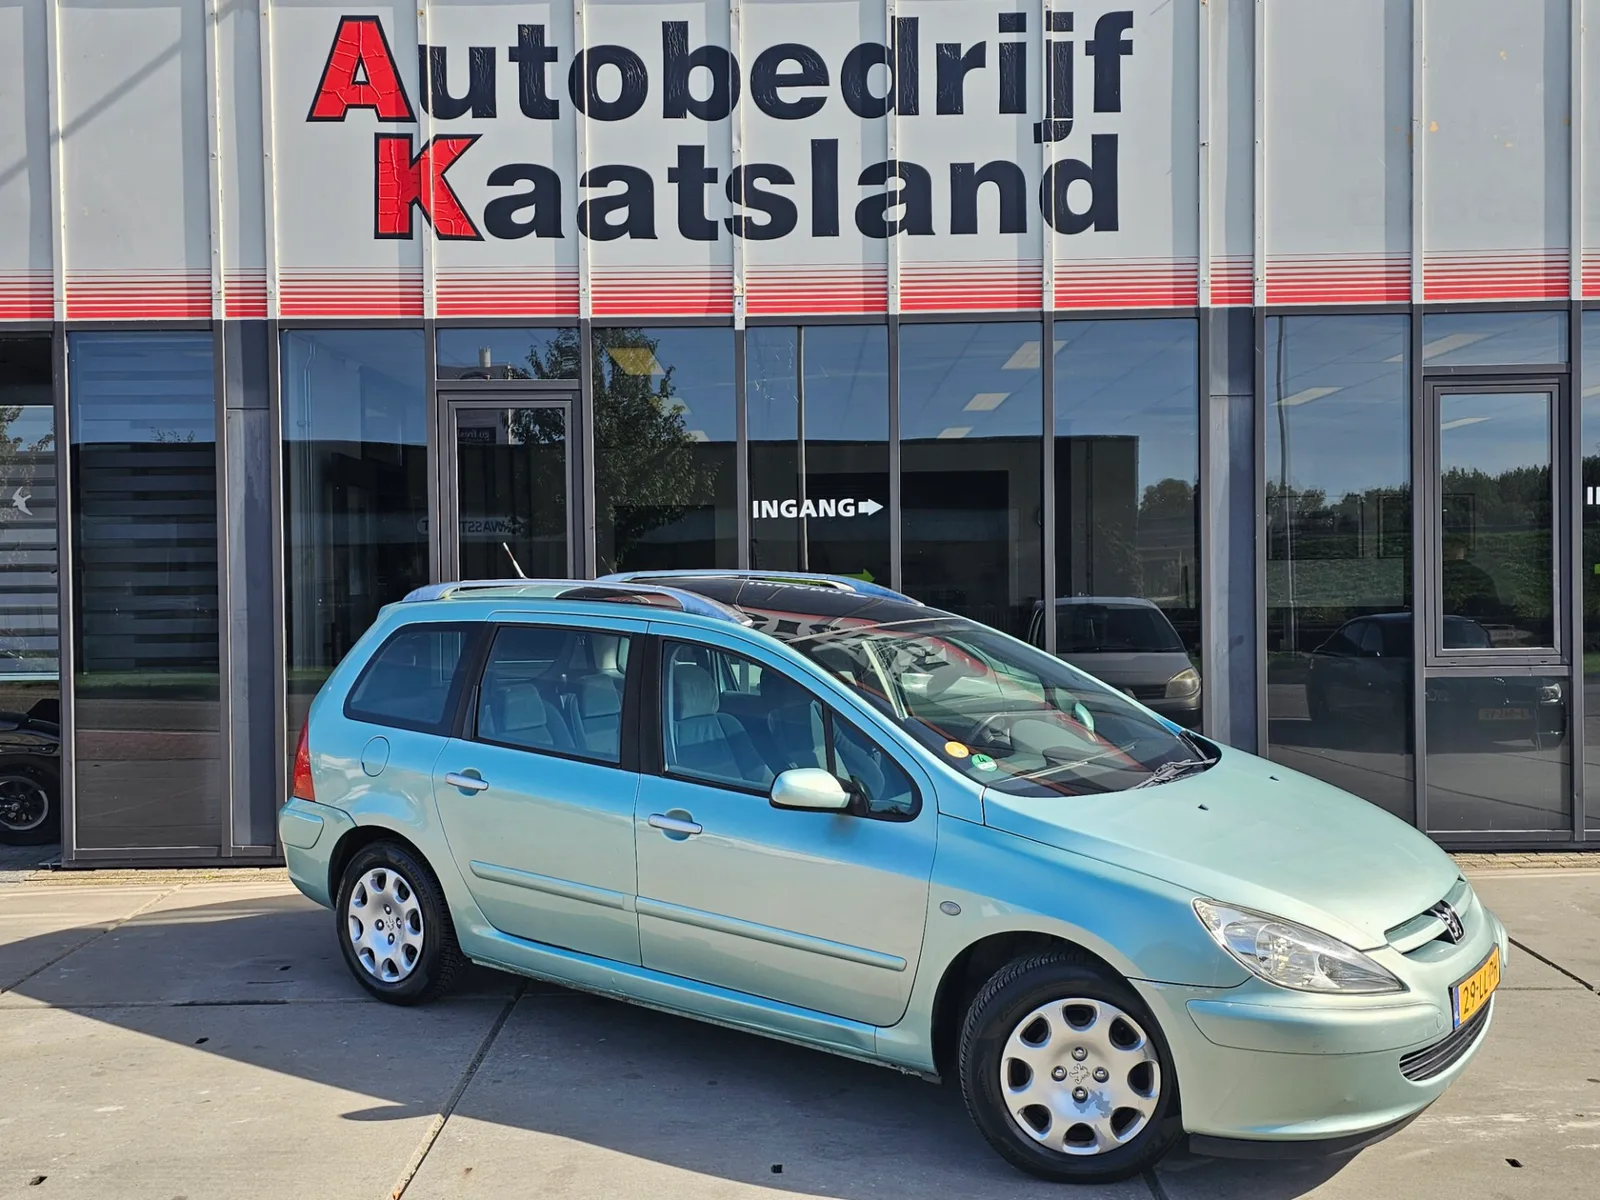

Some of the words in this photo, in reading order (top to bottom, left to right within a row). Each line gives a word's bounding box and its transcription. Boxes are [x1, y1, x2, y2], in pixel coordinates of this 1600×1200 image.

[306, 10, 1134, 143] Autobedrijf
[373, 132, 1119, 241] Kaatsland
[752, 498, 856, 519] INGANG
[1587, 486, 1600, 505] I
